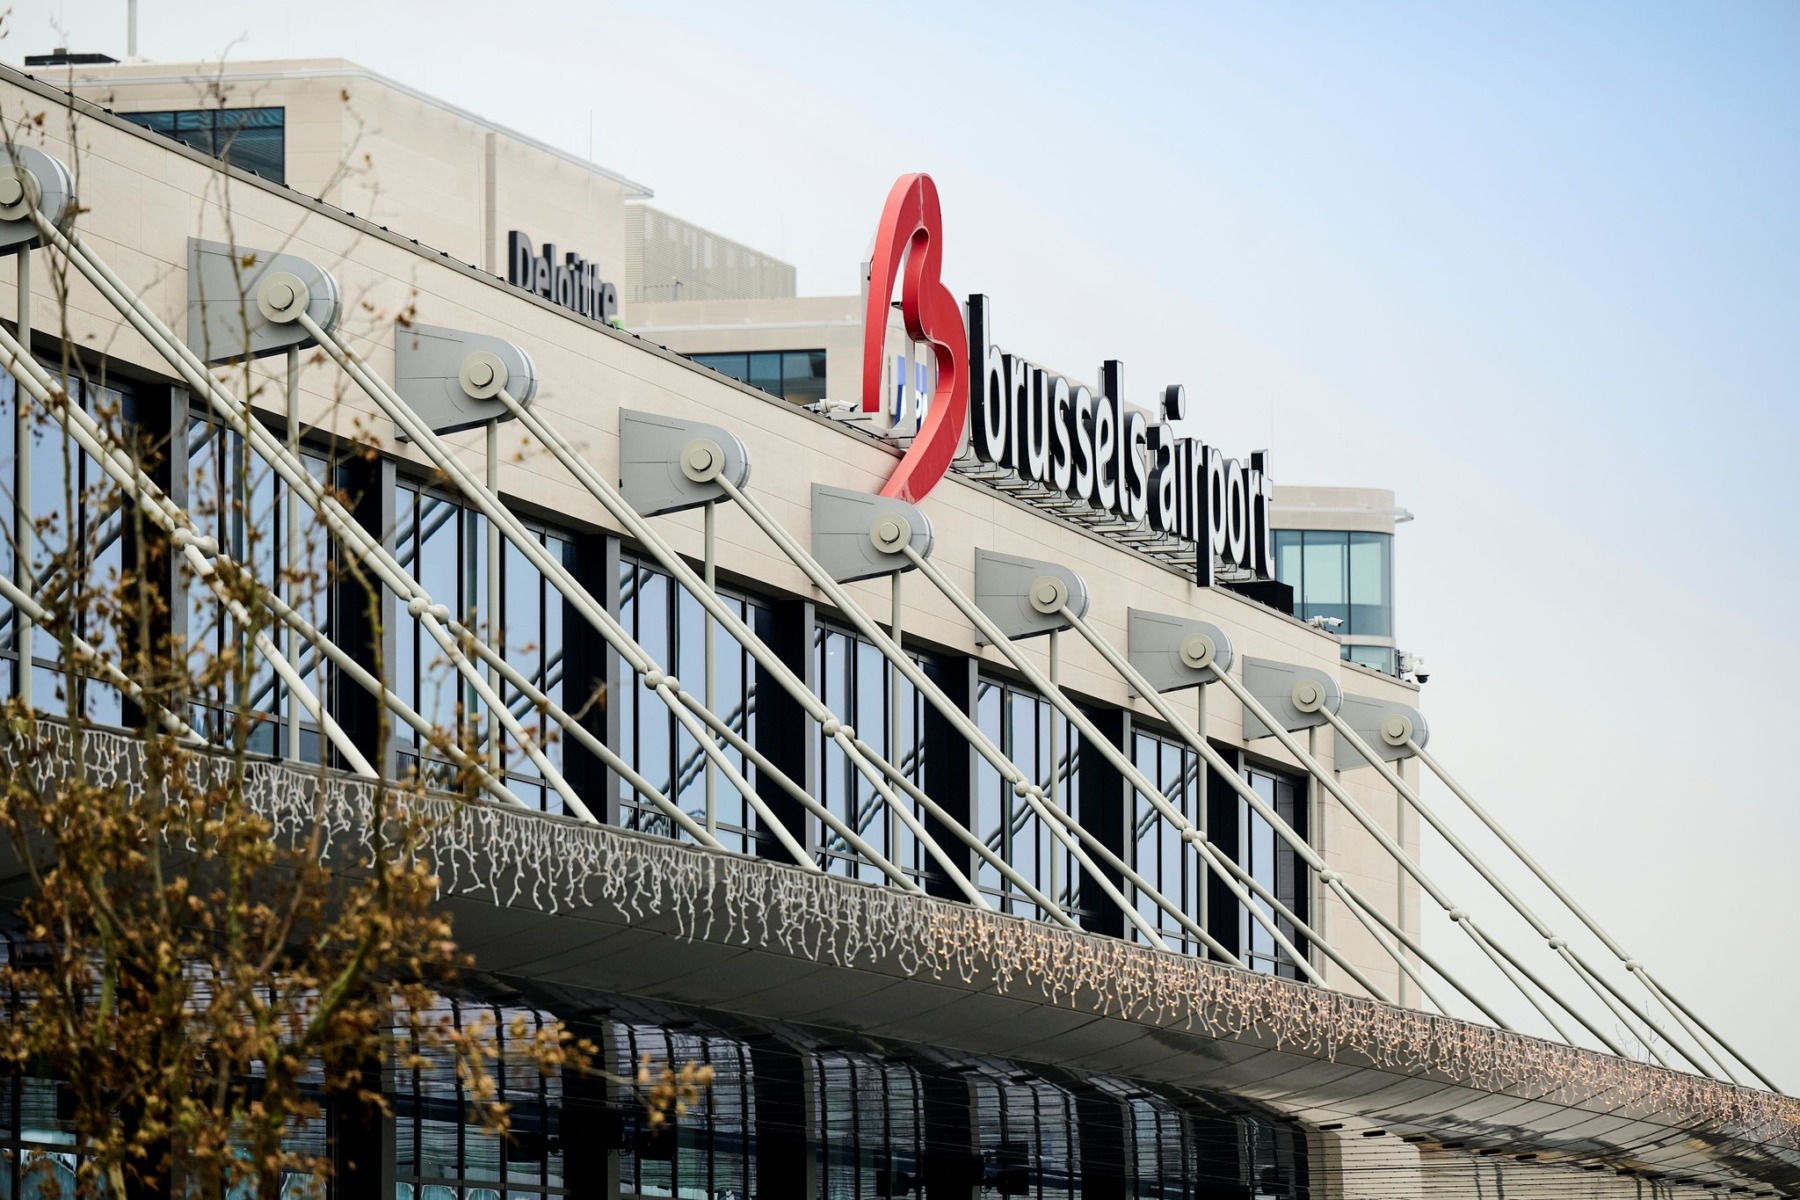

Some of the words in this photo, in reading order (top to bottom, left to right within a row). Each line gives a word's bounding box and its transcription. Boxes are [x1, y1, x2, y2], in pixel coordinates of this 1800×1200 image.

[508, 230, 618, 325] Deloitte
[969, 293, 1147, 522] brussels
[1147, 384, 1275, 588] airport
